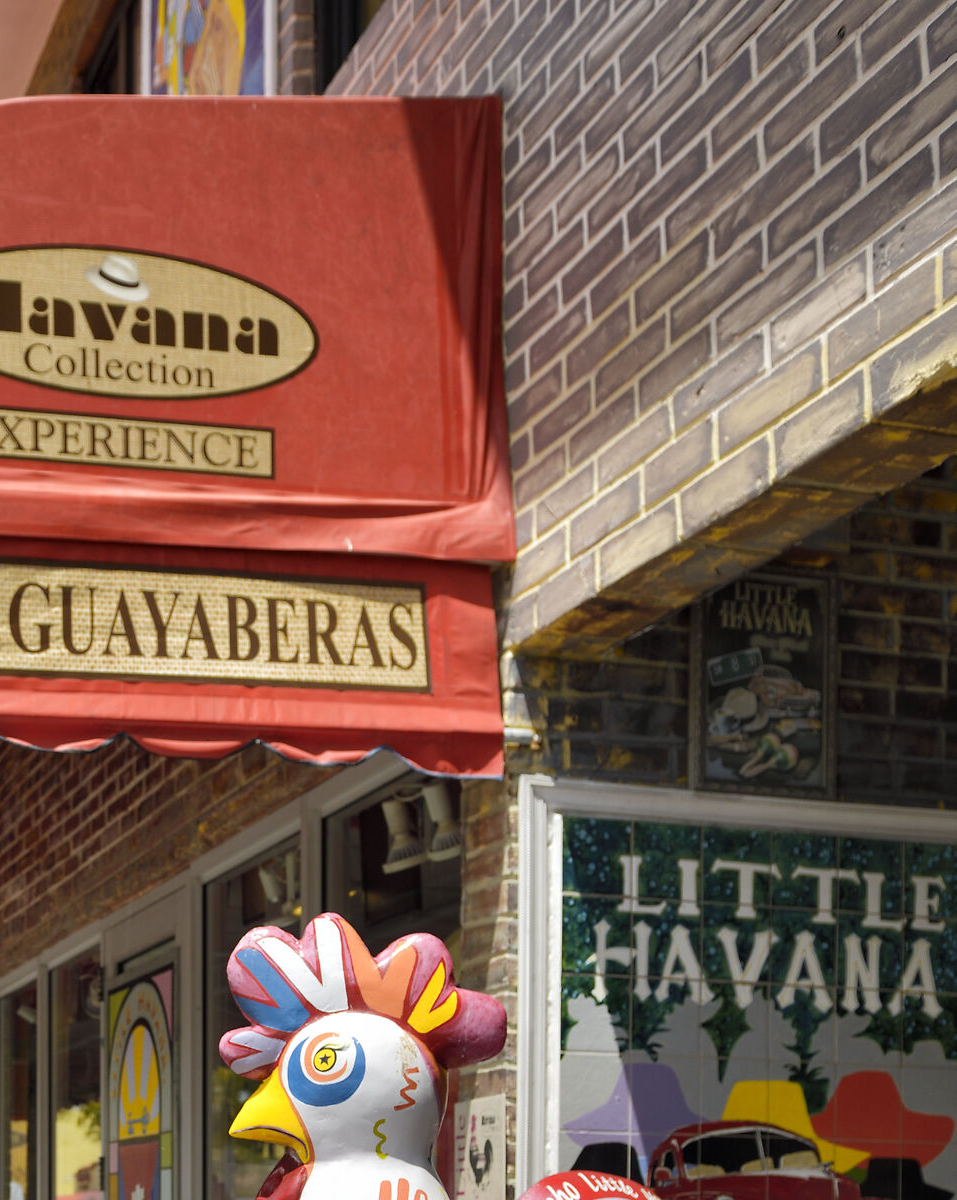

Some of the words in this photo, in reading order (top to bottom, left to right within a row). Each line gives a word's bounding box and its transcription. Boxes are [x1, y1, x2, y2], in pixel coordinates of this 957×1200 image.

[24, 343, 216, 389] Collection
[720, 600, 813, 637] HAVANA
[735, 582, 798, 605] LITTLE
[9, 581, 418, 671] GUAYABERAS
[616, 855, 946, 932] LITTLE
[588, 918, 943, 1019] HAVANA
